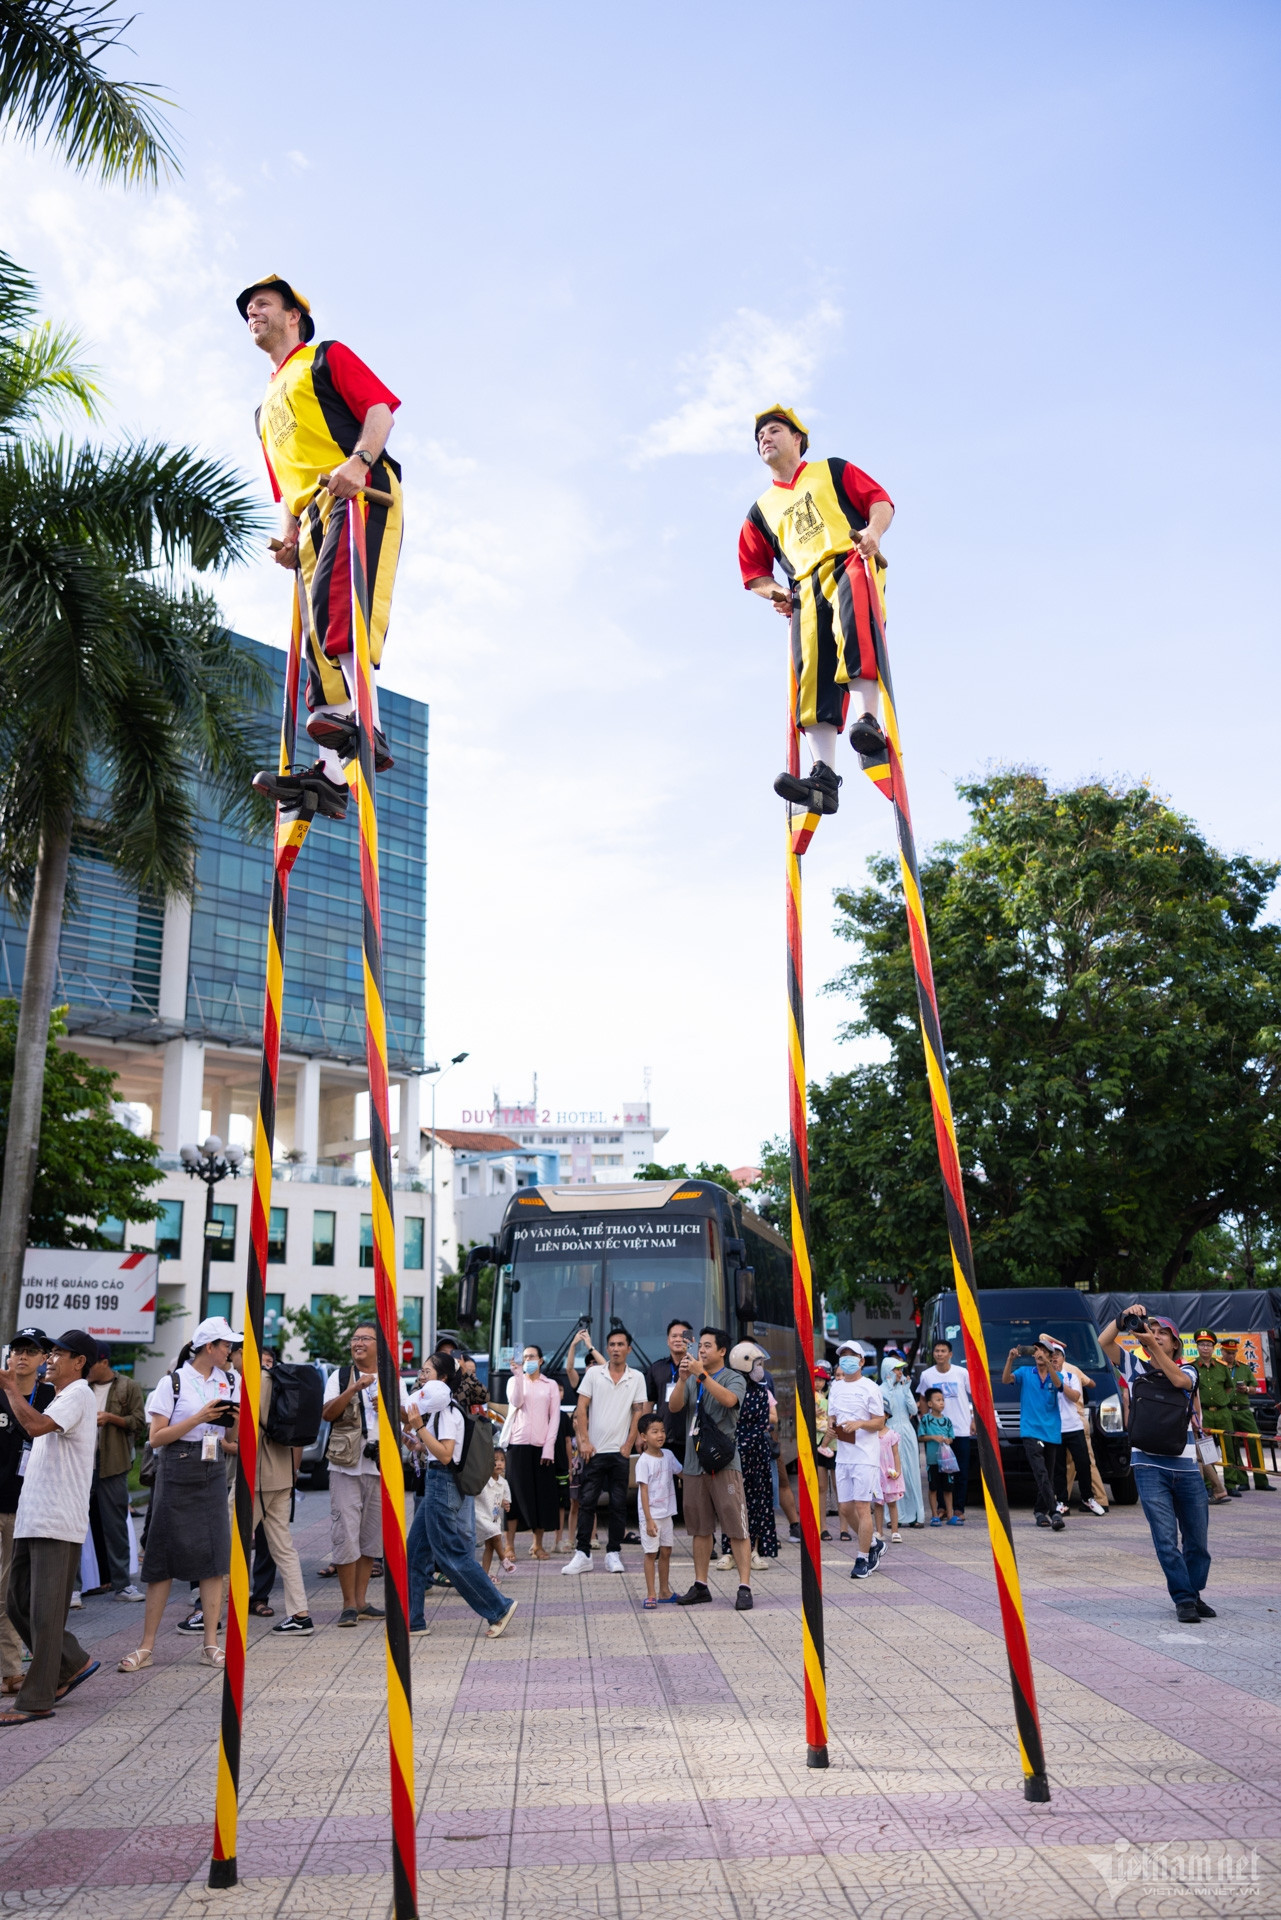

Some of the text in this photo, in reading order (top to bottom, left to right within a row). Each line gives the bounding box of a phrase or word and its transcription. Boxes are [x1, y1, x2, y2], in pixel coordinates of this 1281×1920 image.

[298, 824, 308, 832] 63
[462, 1110, 496, 1124] DUY
[542, 1109, 551, 1123] 2
[557, 1111, 607, 1124] HOTEL
[514, 1222, 701, 1241] BỘ VĂN HÓA, THỂ THAO VÀ DU LỊCH
[535, 1240, 560, 1252] LIÊN
[562, 1238, 592, 1251] ĐOÀN
[623, 1238, 649, 1250] VIỆT
[651, 1238, 676, 1248] NAM
[22, 1276, 125, 1290] LIÊN HỆ QUẢNG CÁO
[25, 1293, 119, 1311] 0912 469 199
